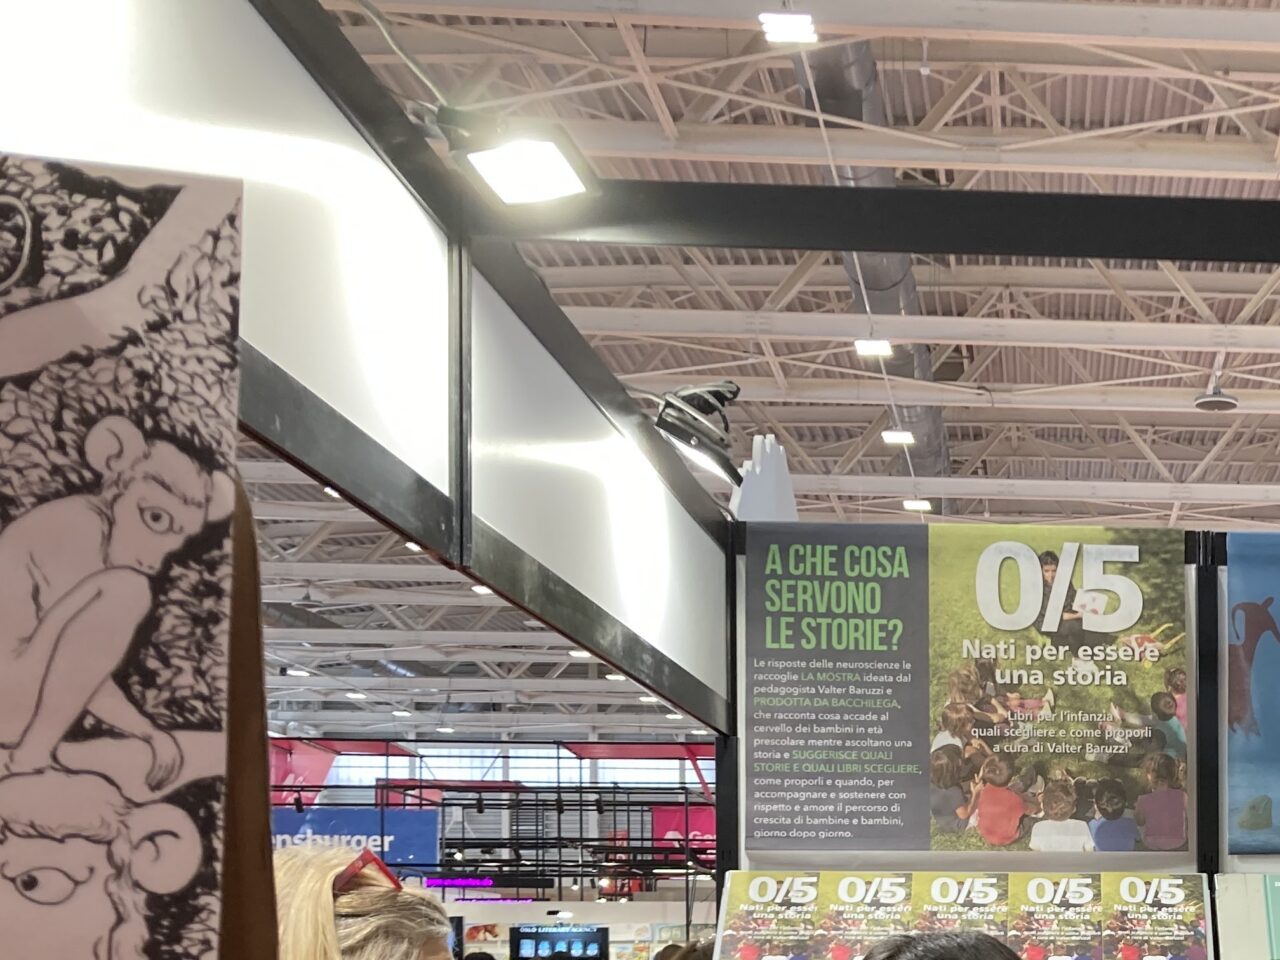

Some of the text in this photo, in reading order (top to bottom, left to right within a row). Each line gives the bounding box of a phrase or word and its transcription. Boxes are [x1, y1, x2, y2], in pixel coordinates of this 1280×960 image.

[765, 544, 910, 578] A CHE COSA
[975, 540, 1144, 633] 0/5
[765, 579, 881, 614] SERVONO
[766, 616, 903, 650] LE STORIE?
[962, 639, 1160, 664] Nati per essere
[754, 659, 911, 670] Le risposte delle neuroscienze le
[754, 672, 911, 682] raccoglie LA MOSTRA ideata dal
[995, 665, 1128, 686] una storia
[754, 685, 815, 695] pedagogista
[818, 686, 846, 694] Valter
[849, 686, 883, 694] Baruzzi
[754, 698, 811, 706] PRODOTTA
[814, 698, 829, 706] DA
[754, 711, 771, 719] che
[774, 712, 815, 720] racconta
[843, 712, 878, 721] accade
[881, 712, 889, 721] al
[1008, 711, 1033, 721] Libri
[1036, 713, 1056, 724] per
[754, 724, 792, 732] cervello
[795, 724, 810, 733] dei
[813, 725, 853, 733] bambini
[971, 726, 1152, 740] quali scegliere e come proporli
[754, 737, 805, 747] prescolare
[808, 739, 842, 747] mentre
[845, 738, 892, 747] ascoltano
[993, 743, 1128, 754] a cura di Valter Baruzzi
[754, 751, 781, 759] storia
[792, 750, 858, 759] SUGGERISCE
[861, 751, 892, 760] QUALI
[754, 763, 791, 772] STORIE
[793, 764, 799, 772] E
[802, 764, 834, 773] QUALI
[837, 764, 861, 772] LIBRI
[784, 777, 823, 787] proporli
[878, 779, 894, 788] per
[754, 791, 827, 800] accompagnare
[754, 803, 792, 813] rispetto
[837, 803, 843, 811] il
[845, 805, 888, 813] percorso
[891, 804, 900, 812] di
[754, 816, 791, 824] crescita
[794, 816, 803, 824] di
[806, 817, 849, 825] bambine
[754, 829, 787, 838] giorno
[789, 829, 816, 838] dopo
[749, 876, 818, 903] 0/5
[838, 876, 906, 904] 0/5
[930, 877, 998, 904] 0/5
[1026, 877, 1093, 905] 0/5
[1119, 876, 1185, 904] 0/5
[739, 904, 763, 912] Nati
[767, 905, 785, 913] per
[1140, 905, 1158, 913] per
[1151, 912, 1183, 920] storia
